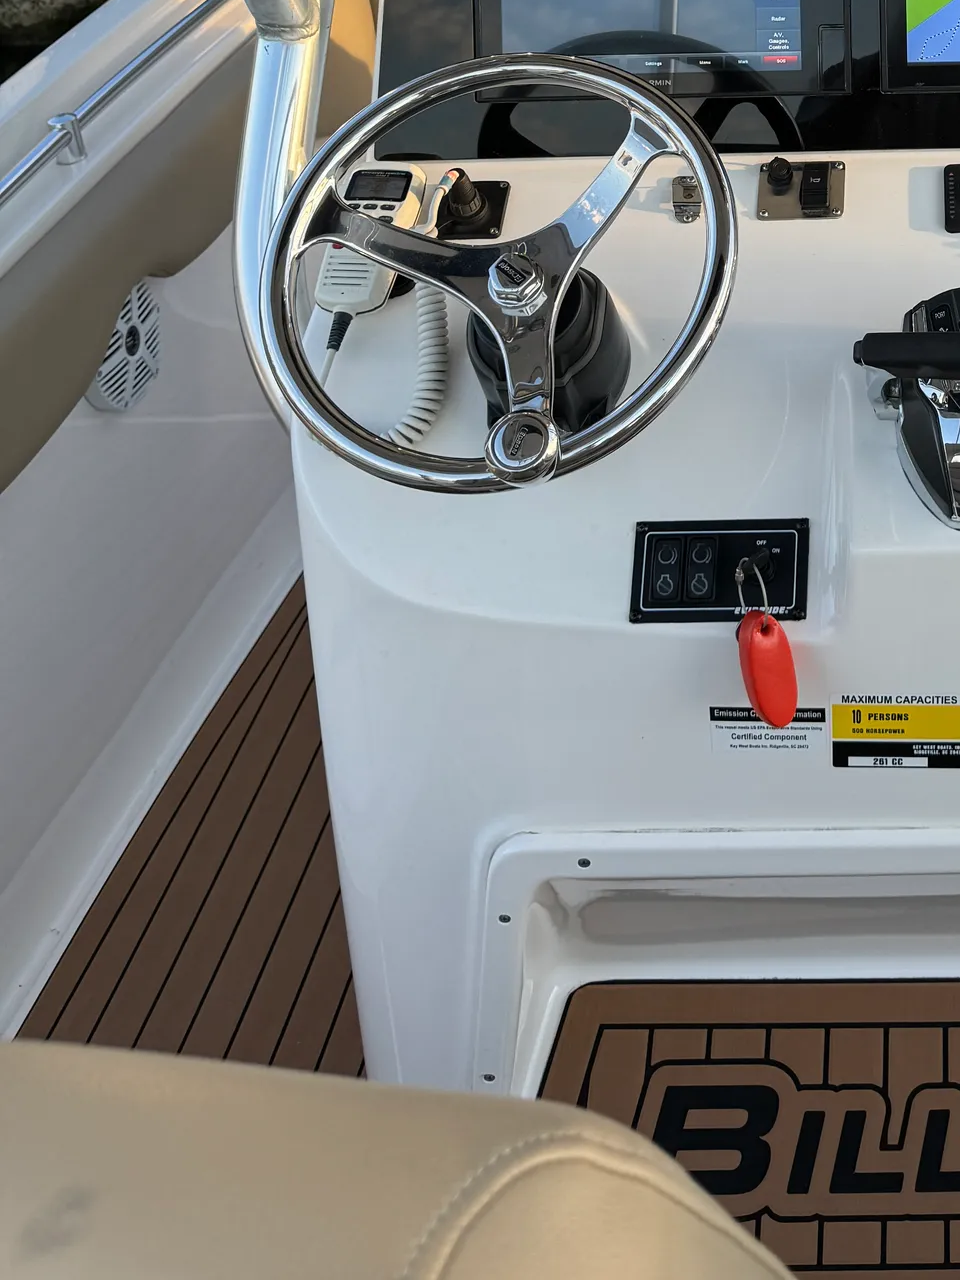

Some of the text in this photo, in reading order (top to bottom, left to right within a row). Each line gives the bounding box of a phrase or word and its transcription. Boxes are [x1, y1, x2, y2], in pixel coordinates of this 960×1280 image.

[934, 310, 946, 320] PORT
[842, 695, 958, 705] MAXIMUM CAPACITIES
[714, 709, 749, 717] Emission
[852, 709, 909, 724] 10 PERSONS
[764, 733, 807, 742] Component
[892, 758, 903, 766] CC
